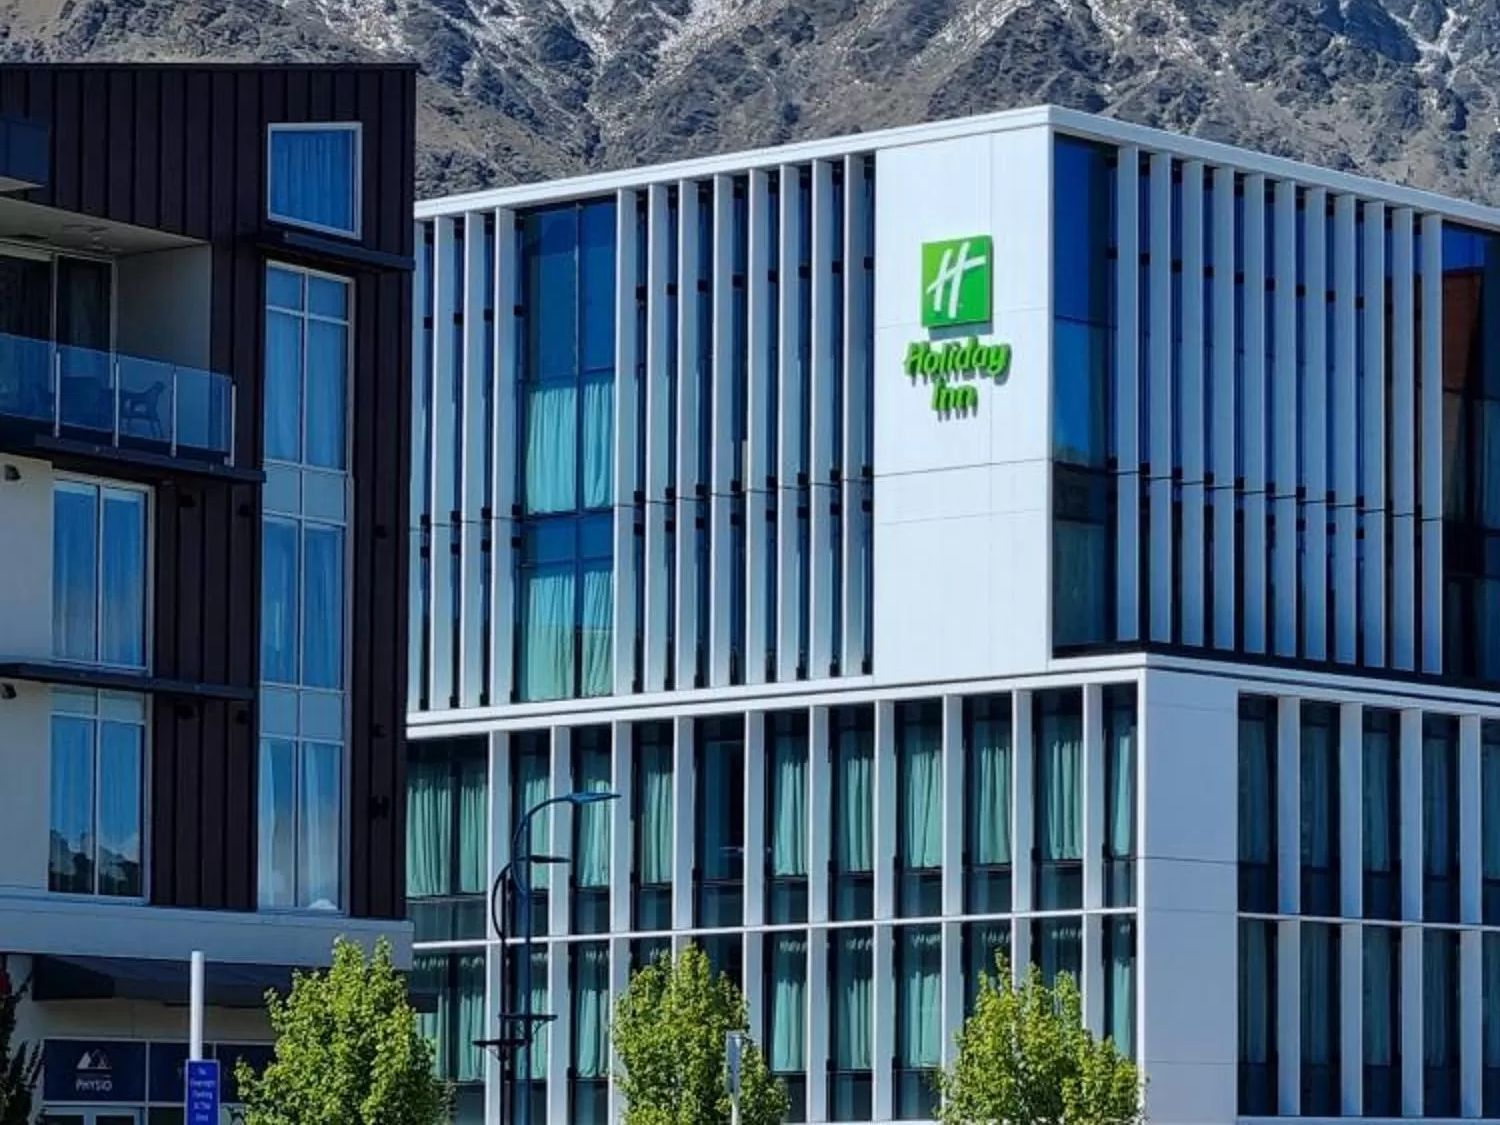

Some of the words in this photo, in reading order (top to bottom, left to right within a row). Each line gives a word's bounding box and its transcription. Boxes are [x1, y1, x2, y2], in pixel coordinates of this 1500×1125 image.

[905, 336, 1010, 377] Holiday
[932, 378, 977, 412] Inn
[75, 1078, 113, 1092] PHYSIO
